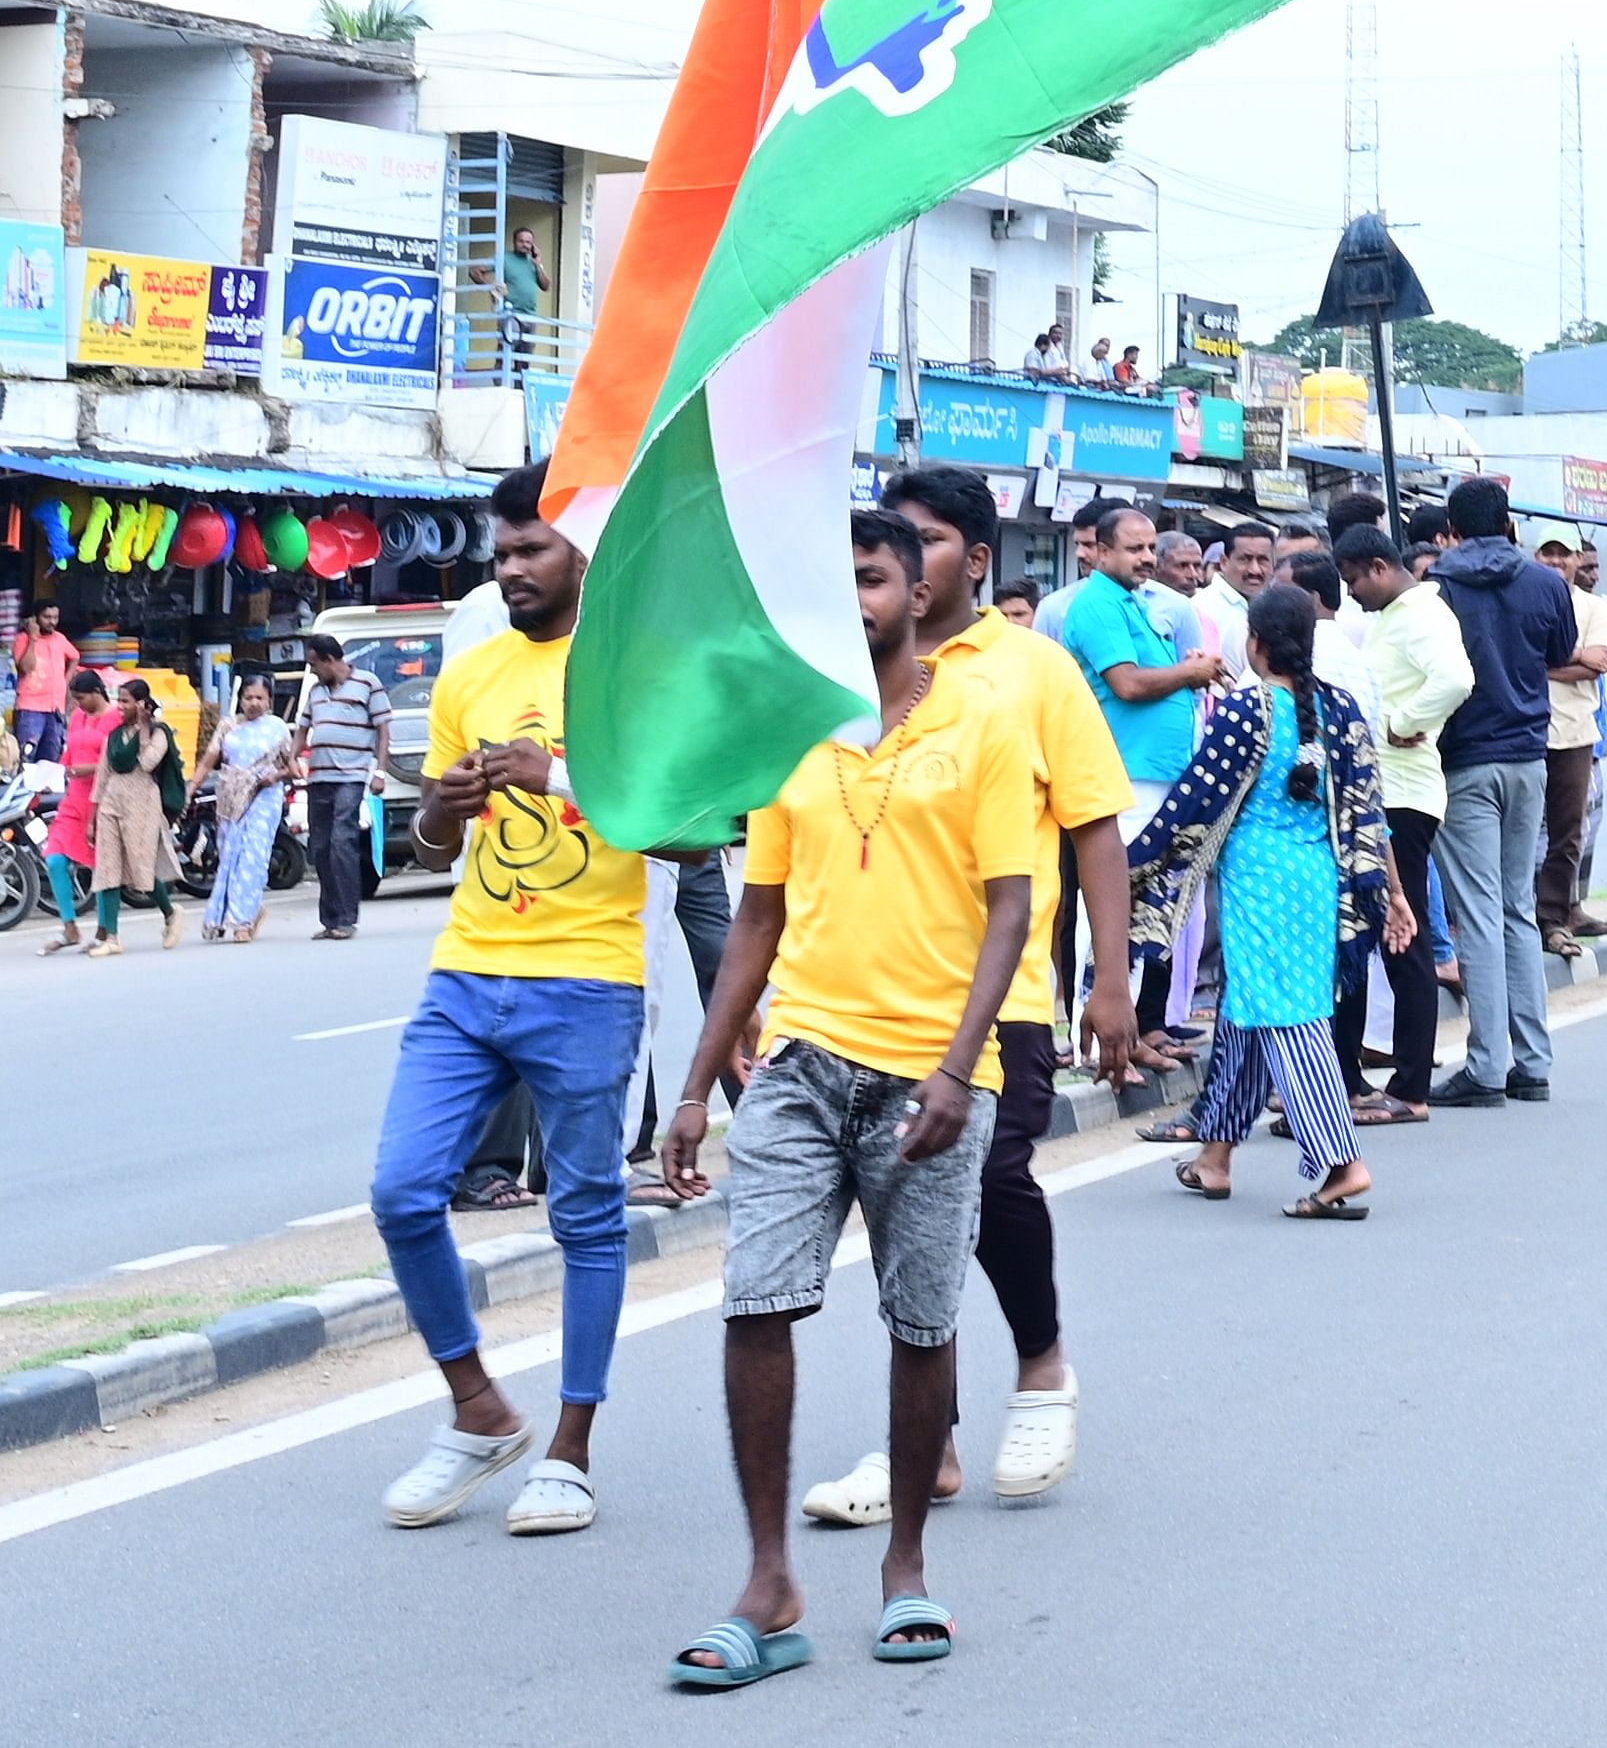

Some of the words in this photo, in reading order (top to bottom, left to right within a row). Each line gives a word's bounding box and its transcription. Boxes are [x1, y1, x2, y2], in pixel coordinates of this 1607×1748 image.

[306, 286, 435, 344] ORBIT
[391, 373, 435, 391] ELECTRICALS
[1079, 421, 1109, 447] Apollo
[1109, 424, 1163, 451] PHARMACY
